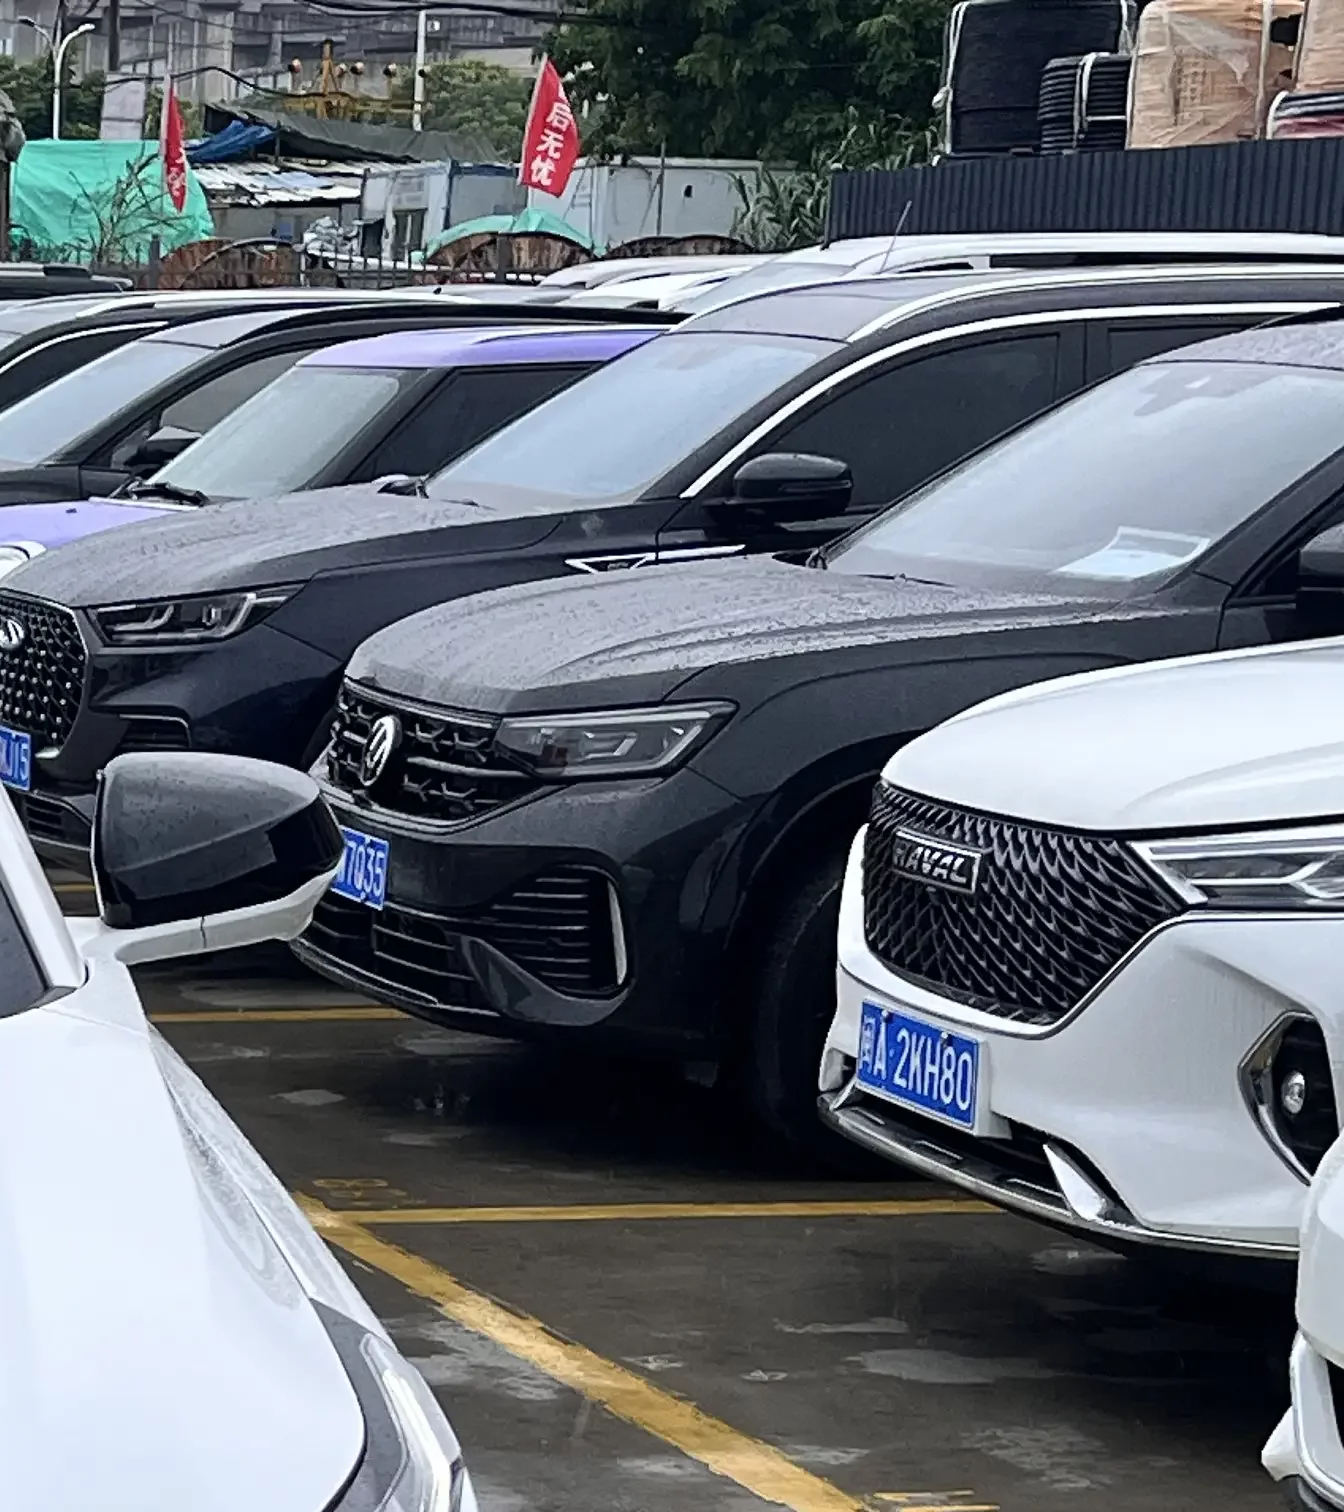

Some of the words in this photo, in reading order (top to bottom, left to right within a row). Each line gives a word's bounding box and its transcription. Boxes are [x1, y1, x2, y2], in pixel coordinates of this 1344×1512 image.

[530, 94, 574, 187] 后无忧
[893, 838, 967, 884] HAVAL
